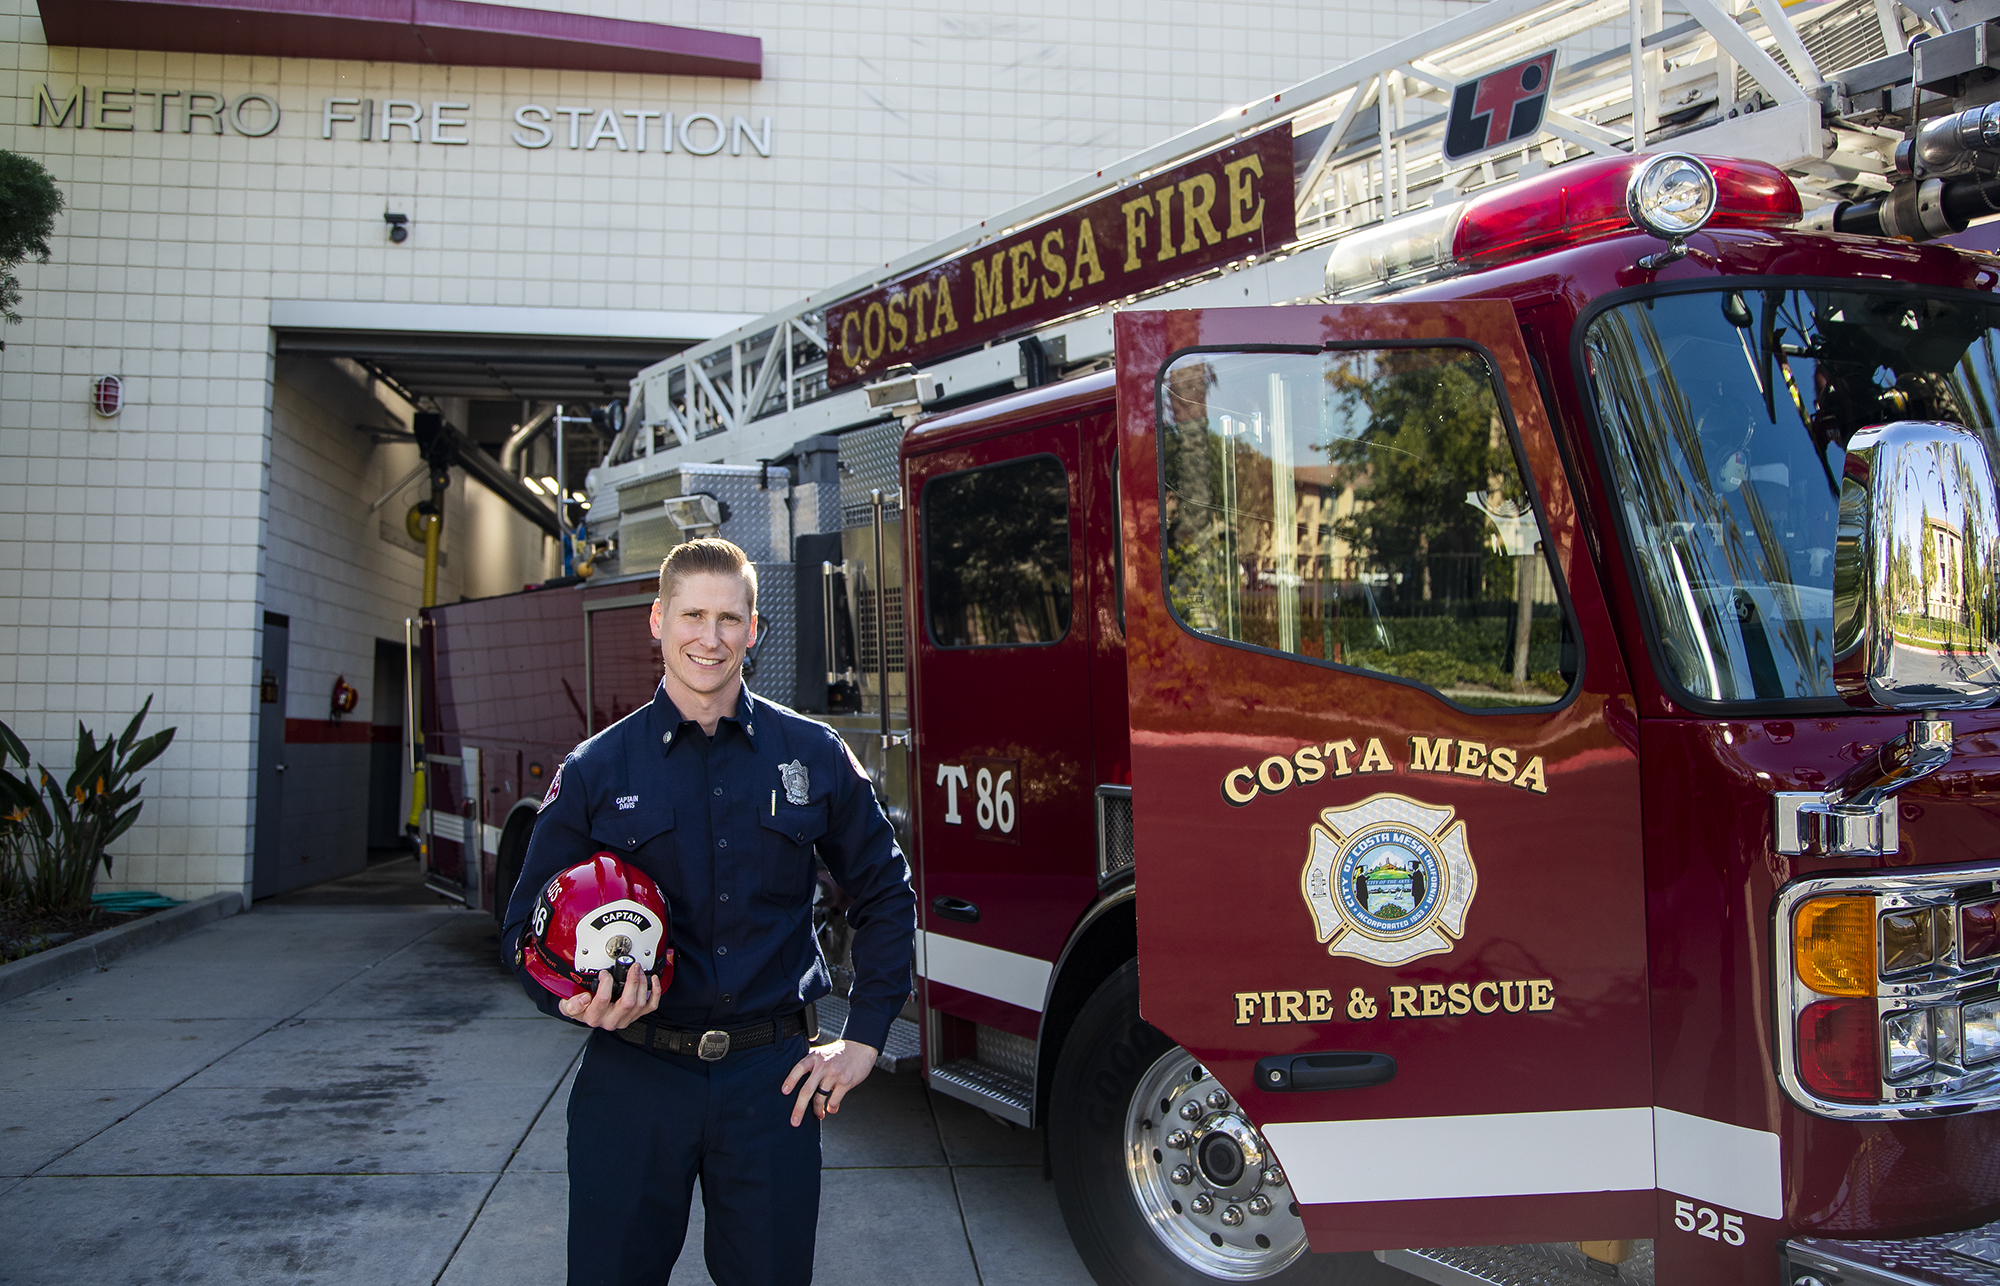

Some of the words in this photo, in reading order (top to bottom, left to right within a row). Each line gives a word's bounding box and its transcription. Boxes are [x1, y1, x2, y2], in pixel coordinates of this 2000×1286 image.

[31, 83, 281, 137] METRO
[322, 98, 469, 145] FIRE
[511, 105, 771, 157] STATION
[841, 275, 959, 369] COSTA
[972, 217, 1105, 324] MESA
[1122, 153, 1266, 274] FIRE
[1221, 738, 1394, 808] COSTA
[1407, 736, 1549, 794] MESA
[615, 795, 639, 804] CAPTAIN
[619, 802, 635, 810] DAVIS
[936, 763, 969, 825] T
[976, 767, 1015, 834] 86
[1352, 832, 1390, 857] COSTA
[1392, 833, 1427, 855] MESA
[1343, 856, 1354, 873] OF
[1423, 854, 1438, 905] CALIFORNIA
[1342, 877, 1355, 908] CITY
[602, 912, 643, 925] CAPTAIN
[1356, 911, 1409, 930] INCORPORATED
[1410, 909, 1425, 923] 1953
[1234, 989, 1334, 1025] FIRE
[1346, 987, 1378, 1020] &
[1390, 979, 1556, 1018] RESCUE
[1674, 1200, 1746, 1246] 525
